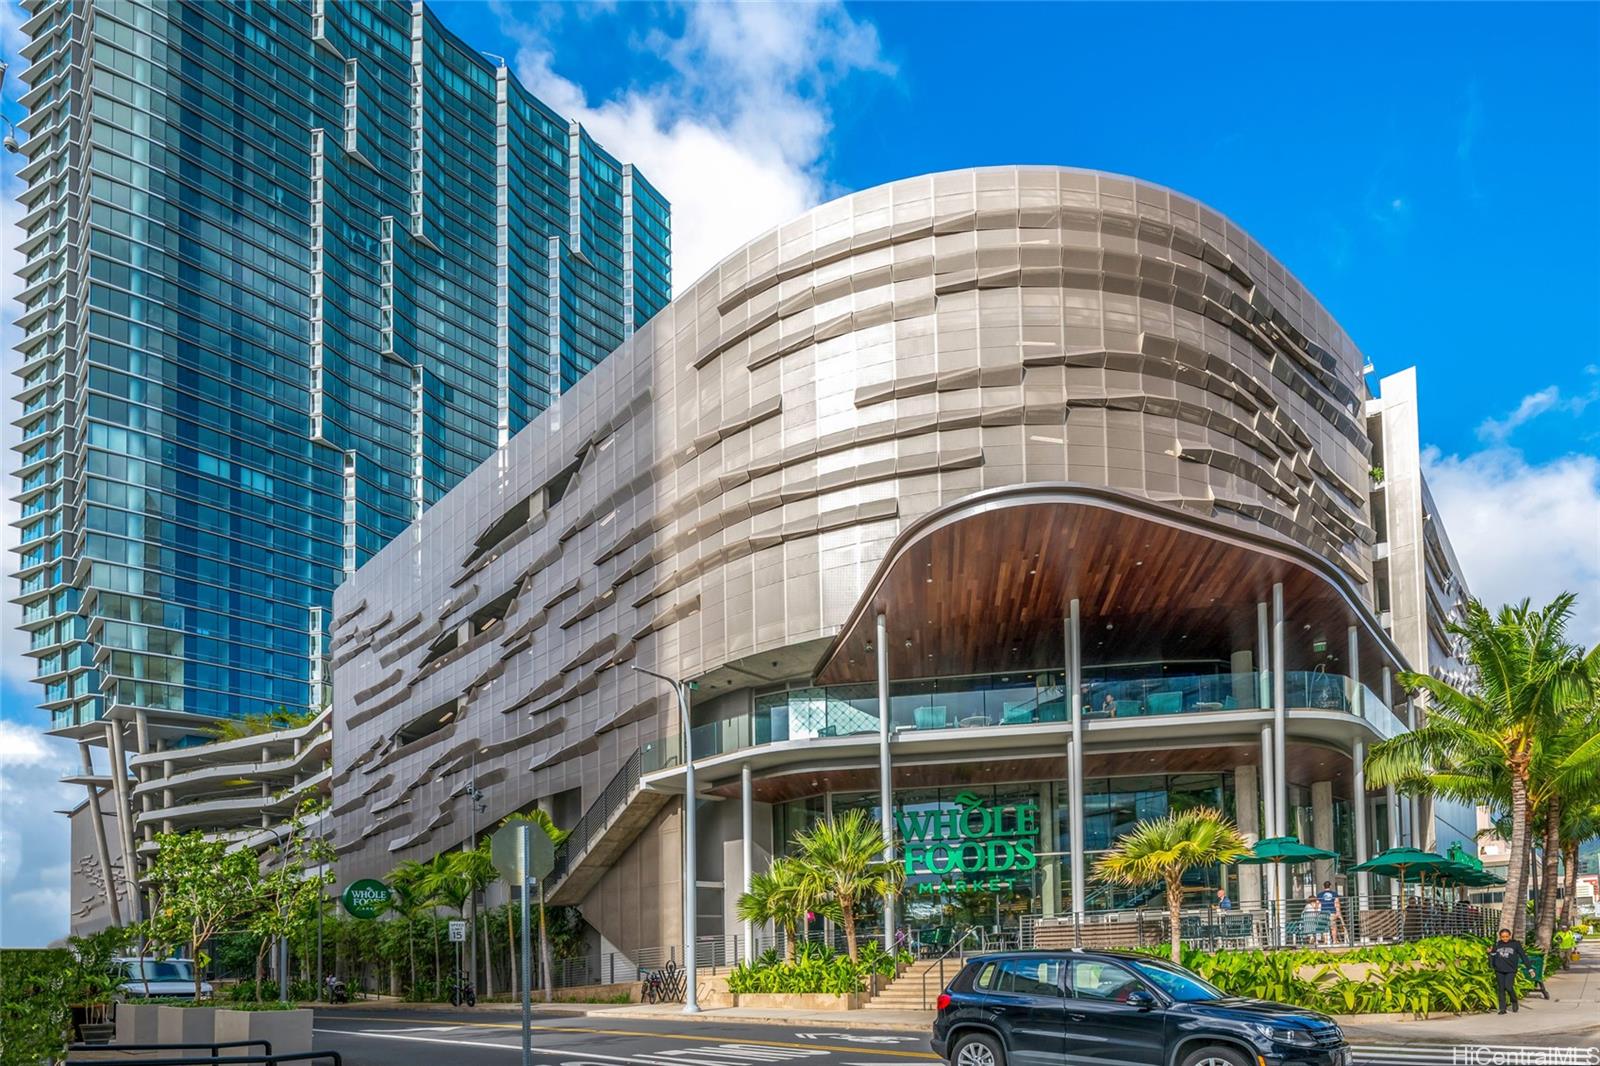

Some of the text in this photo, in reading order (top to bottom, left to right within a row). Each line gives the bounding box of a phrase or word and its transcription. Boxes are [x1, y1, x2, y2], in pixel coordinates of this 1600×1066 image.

[893, 803, 1039, 842] WHOLE
[904, 838, 1037, 876] FOODS
[351, 889, 387, 899] WHOLE
[919, 878, 1016, 894] MARKET
[452, 931, 463, 940] 15
